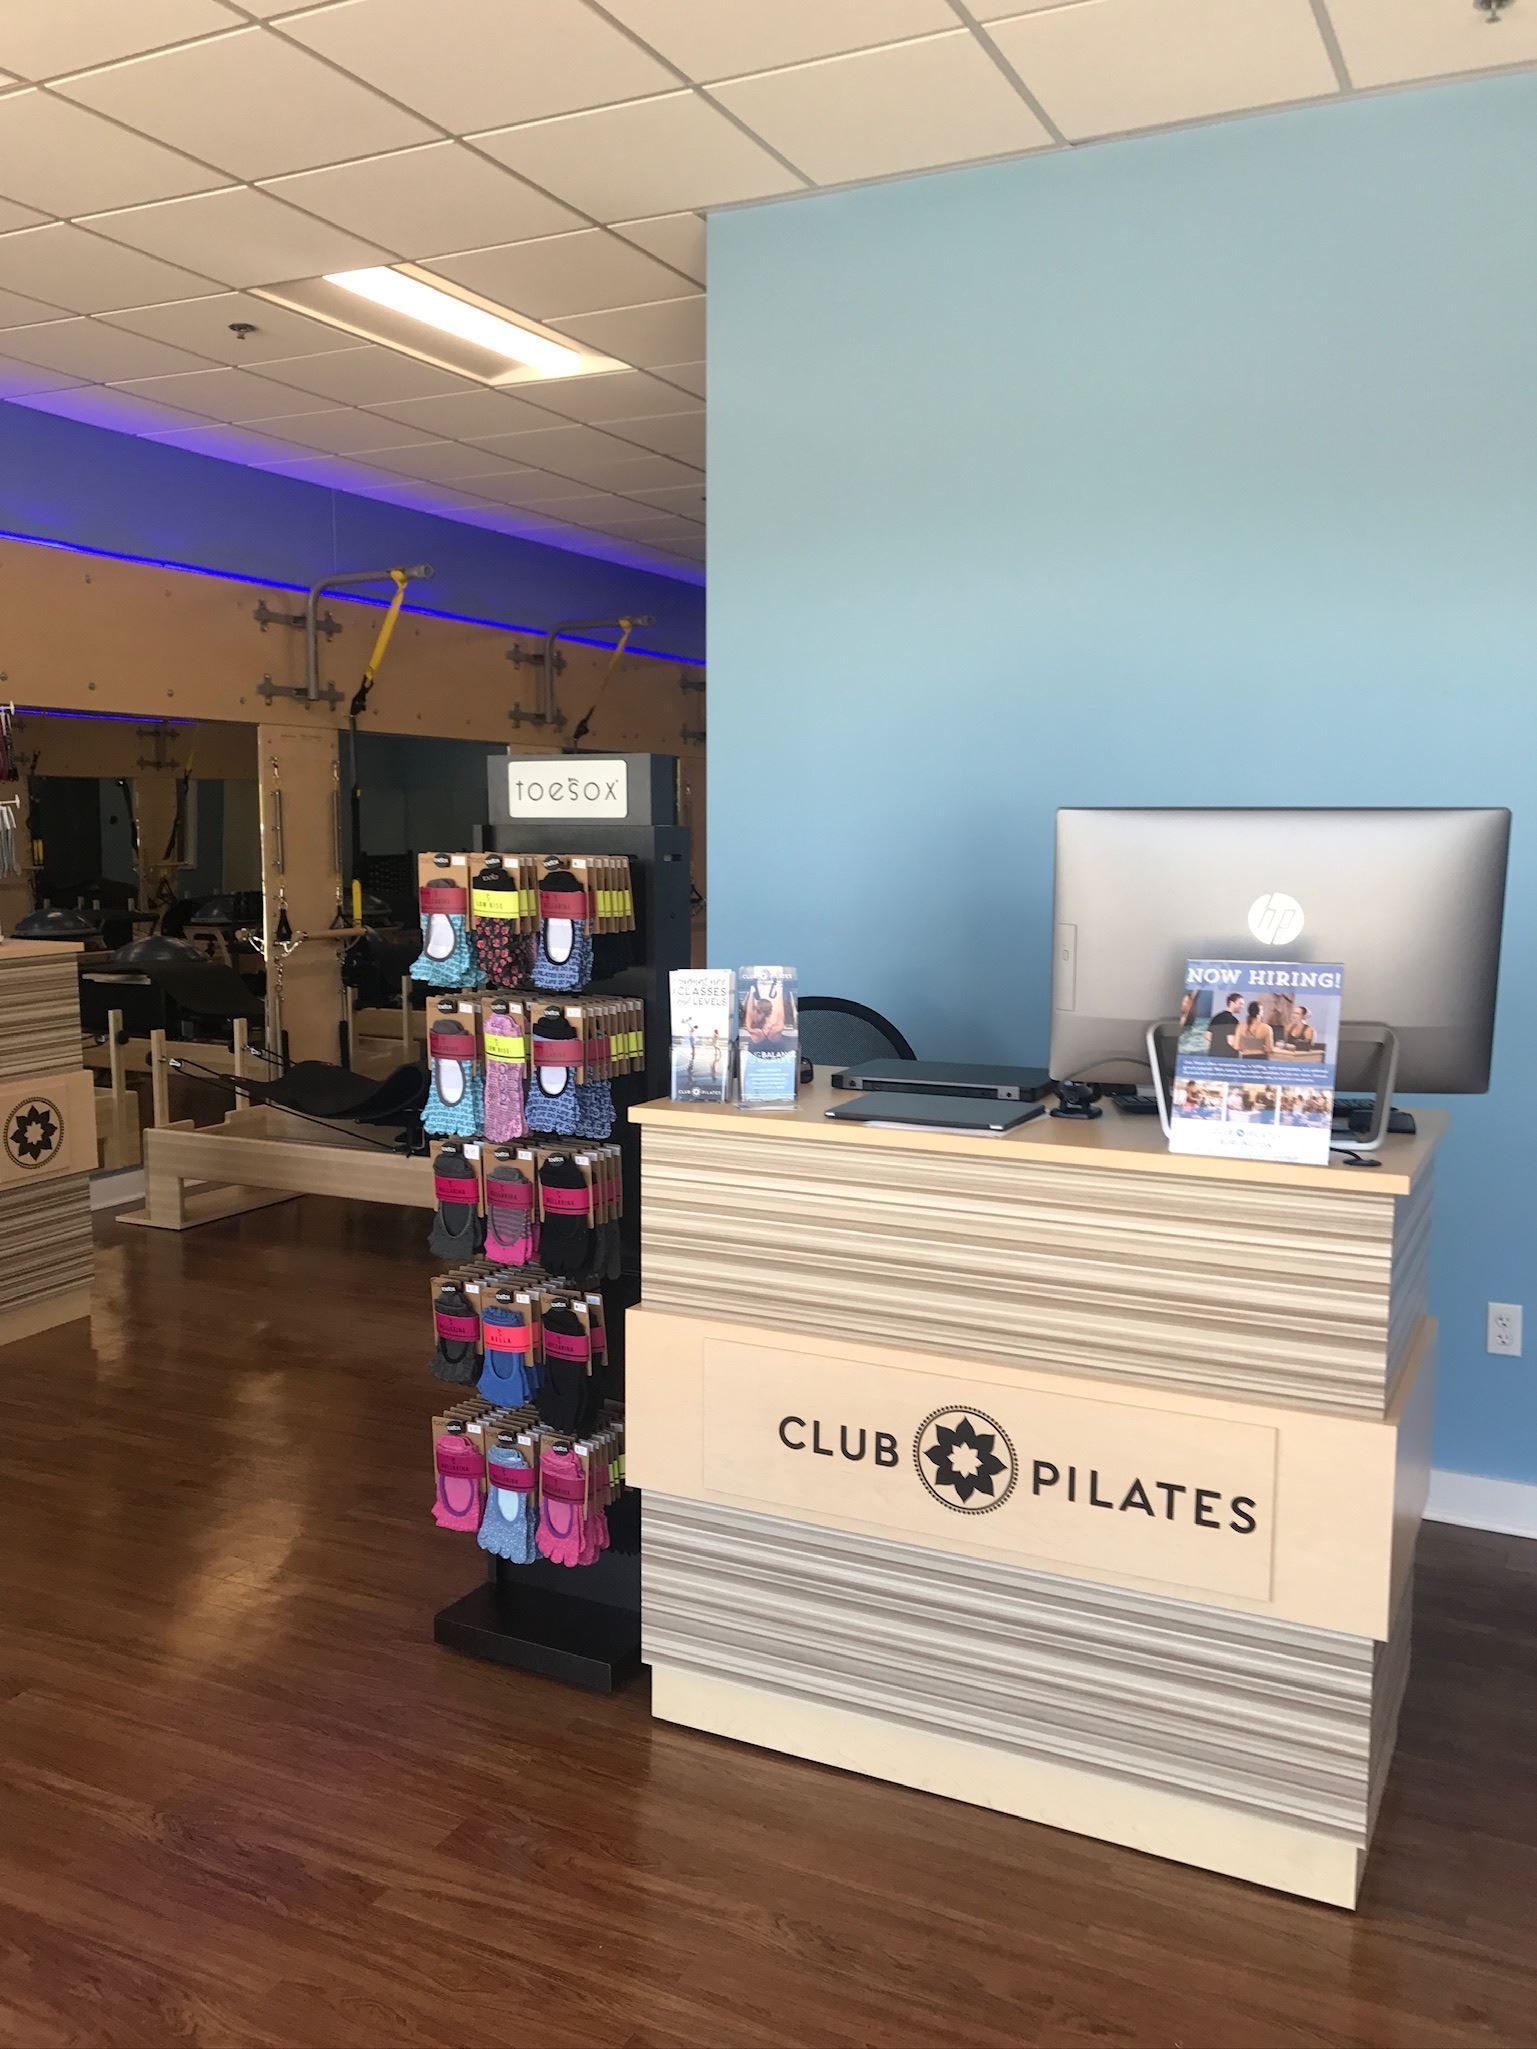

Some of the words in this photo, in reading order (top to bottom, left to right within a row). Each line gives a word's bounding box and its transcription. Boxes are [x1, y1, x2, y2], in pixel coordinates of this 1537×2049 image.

[1252, 892, 1301, 945] hp
[1185, 967, 1242, 985] NOW
[1247, 969, 1342, 989] HIRING!
[677, 986, 727, 997] CLASSES
[692, 997, 727, 1006] LEVELS
[490, 1335, 511, 1344] BELLA
[778, 1415, 900, 1468] CLUB
[1032, 1459, 1258, 1535] PILATES
